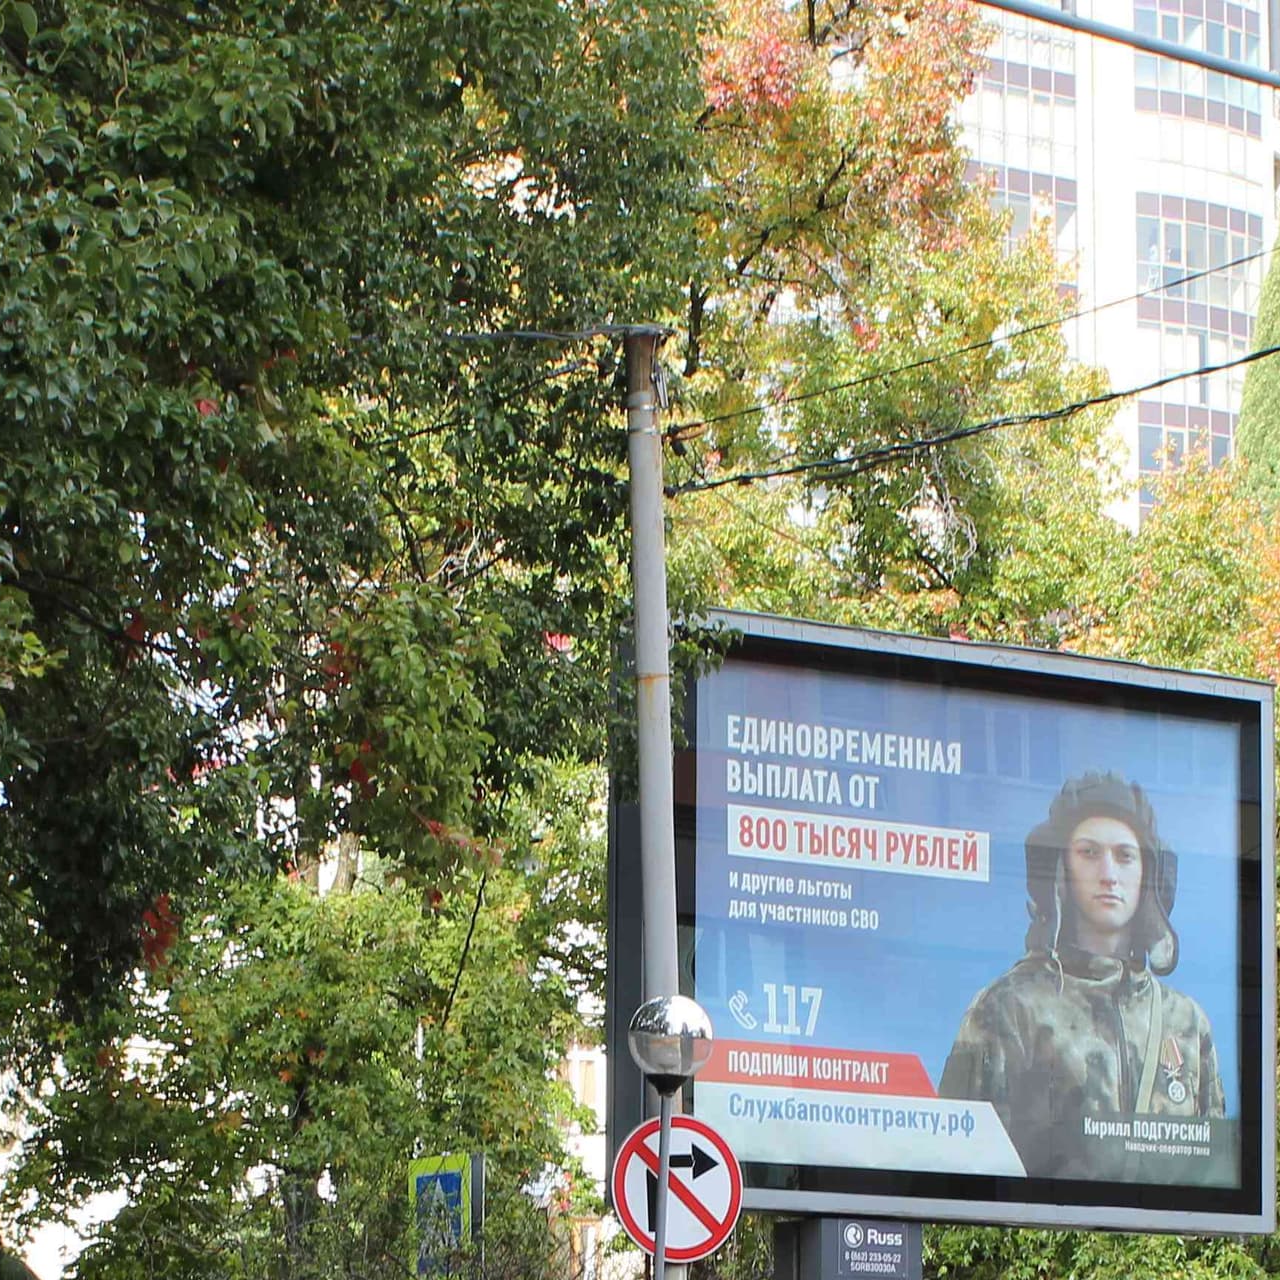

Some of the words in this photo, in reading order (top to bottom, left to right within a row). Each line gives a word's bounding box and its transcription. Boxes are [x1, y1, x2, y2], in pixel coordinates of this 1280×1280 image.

[727, 715, 961, 775] ЕДИНОВРЕМЕННАЯ
[727, 759, 842, 805] ВЫПЛАТА
[849, 774, 880, 808] ОТ
[738, 814, 787, 852] 800
[793, 821, 877, 861] ТЫСЯЧ
[886, 831, 978, 872] РУБЛЕЙ
[729, 871, 739, 889] и
[741, 873, 794, 898] другие
[797, 881, 852, 901] льготы
[728, 899, 757, 919] для
[760, 904, 847, 928] участников
[850, 908, 879, 930] СВО
[762, 982, 823, 1037] 117
[728, 1050, 808, 1078] ПОДПИШИ
[812, 1057, 889, 1084] КОНТРАКТ
[729, 1093, 975, 1137] Службапоконтракту.рф
[1084, 1117, 1130, 1139] Кирилл
[1133, 1120, 1210, 1143] ПОДГУРСКИЙ
[867, 1228, 903, 1246] Russ
